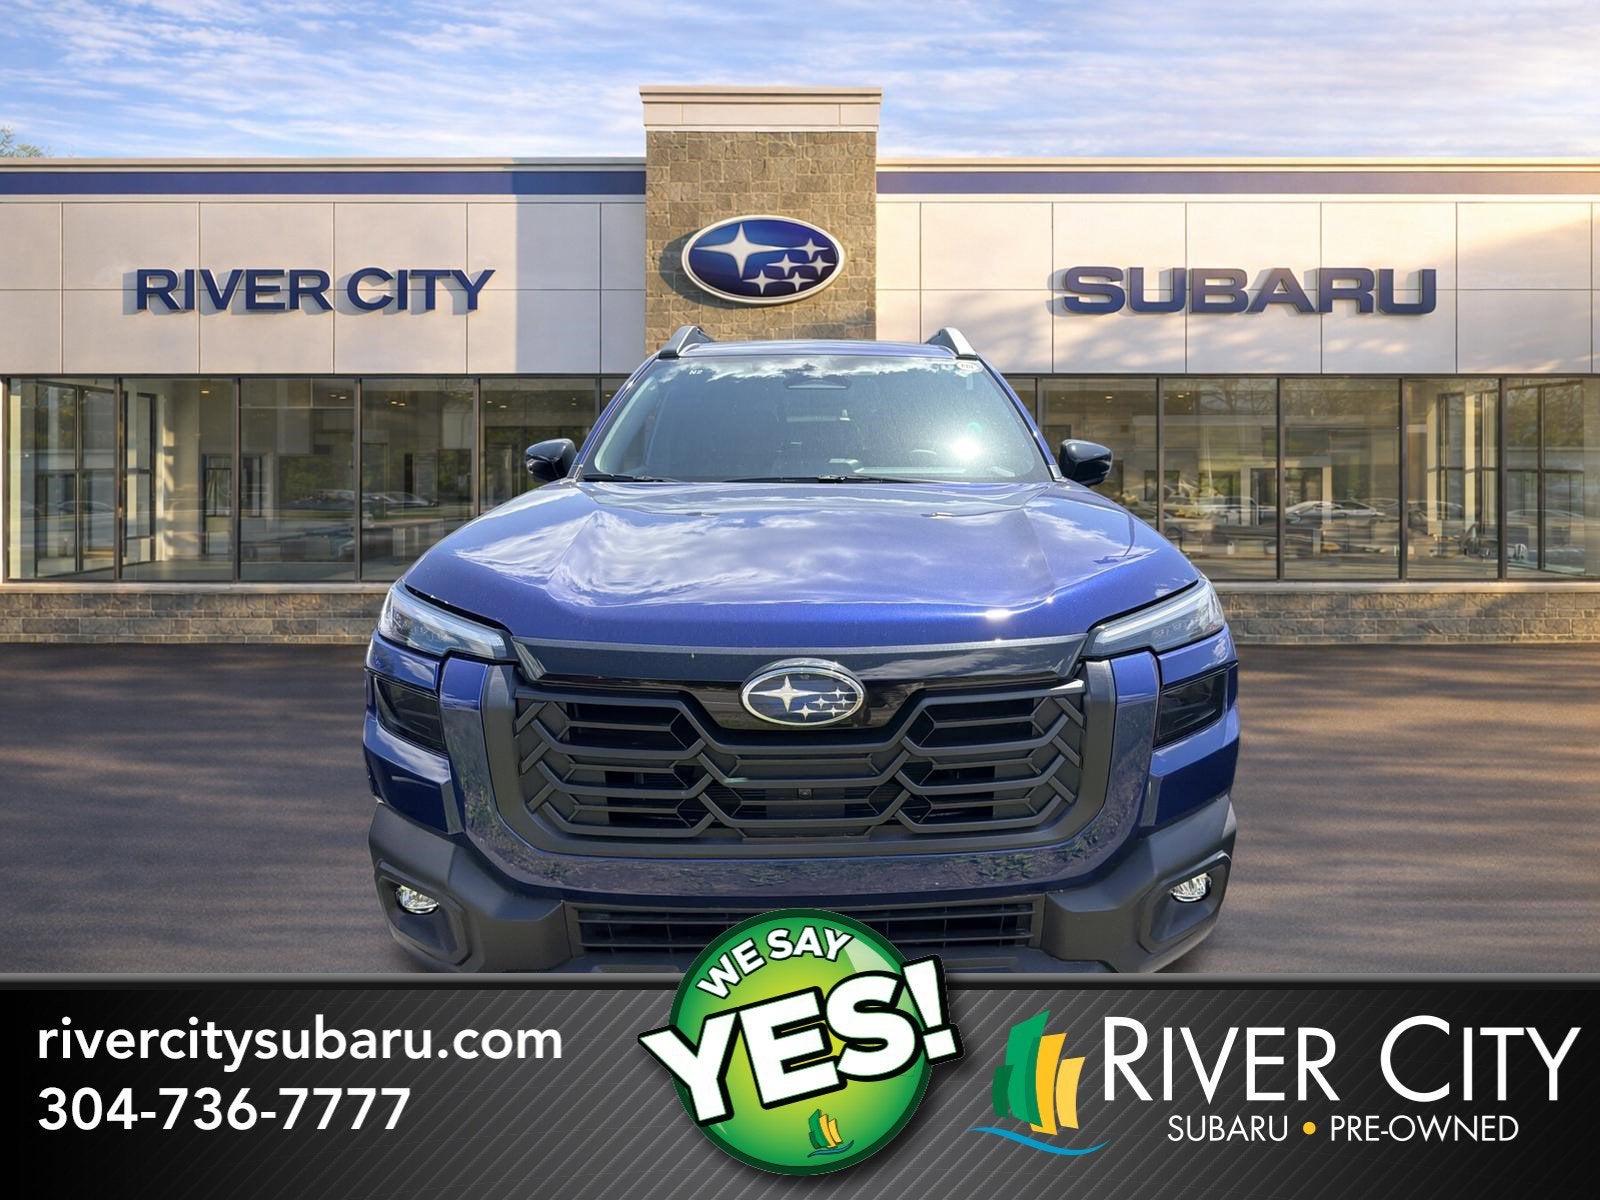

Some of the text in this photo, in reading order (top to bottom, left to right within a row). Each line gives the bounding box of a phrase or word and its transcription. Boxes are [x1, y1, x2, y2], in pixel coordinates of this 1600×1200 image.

[136, 268, 496, 312] RIVER CITY
[1062, 266, 1438, 316] SUBARU
